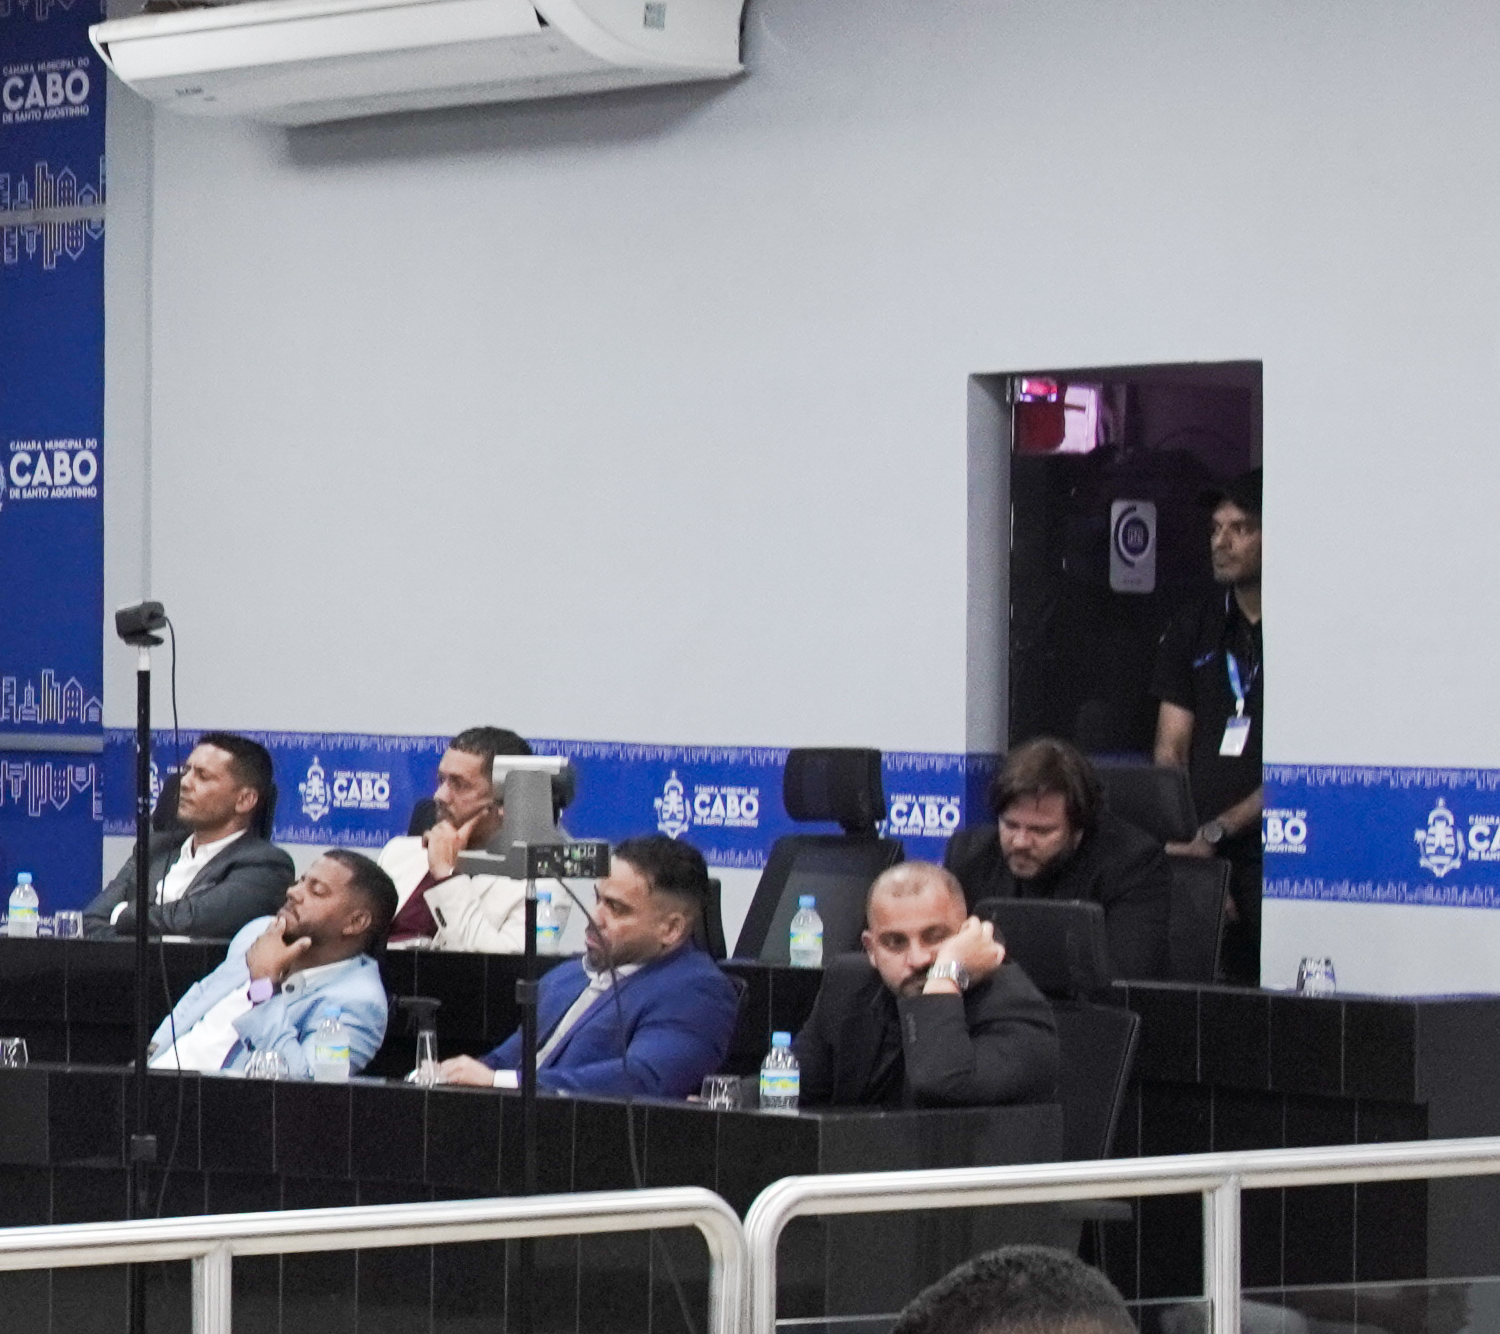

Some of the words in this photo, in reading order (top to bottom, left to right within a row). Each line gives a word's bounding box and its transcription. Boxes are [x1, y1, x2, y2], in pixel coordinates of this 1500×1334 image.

[2, 68, 90, 111] CABO
[9, 450, 98, 487] CABO
[22, 487, 49, 499] SANTO
[50, 485, 97, 499] AGOSTINHO
[333, 778, 390, 802] CABO
[693, 794, 759, 819] CABO
[890, 802, 960, 829] CABO
[1262, 818, 1307, 844] BO
